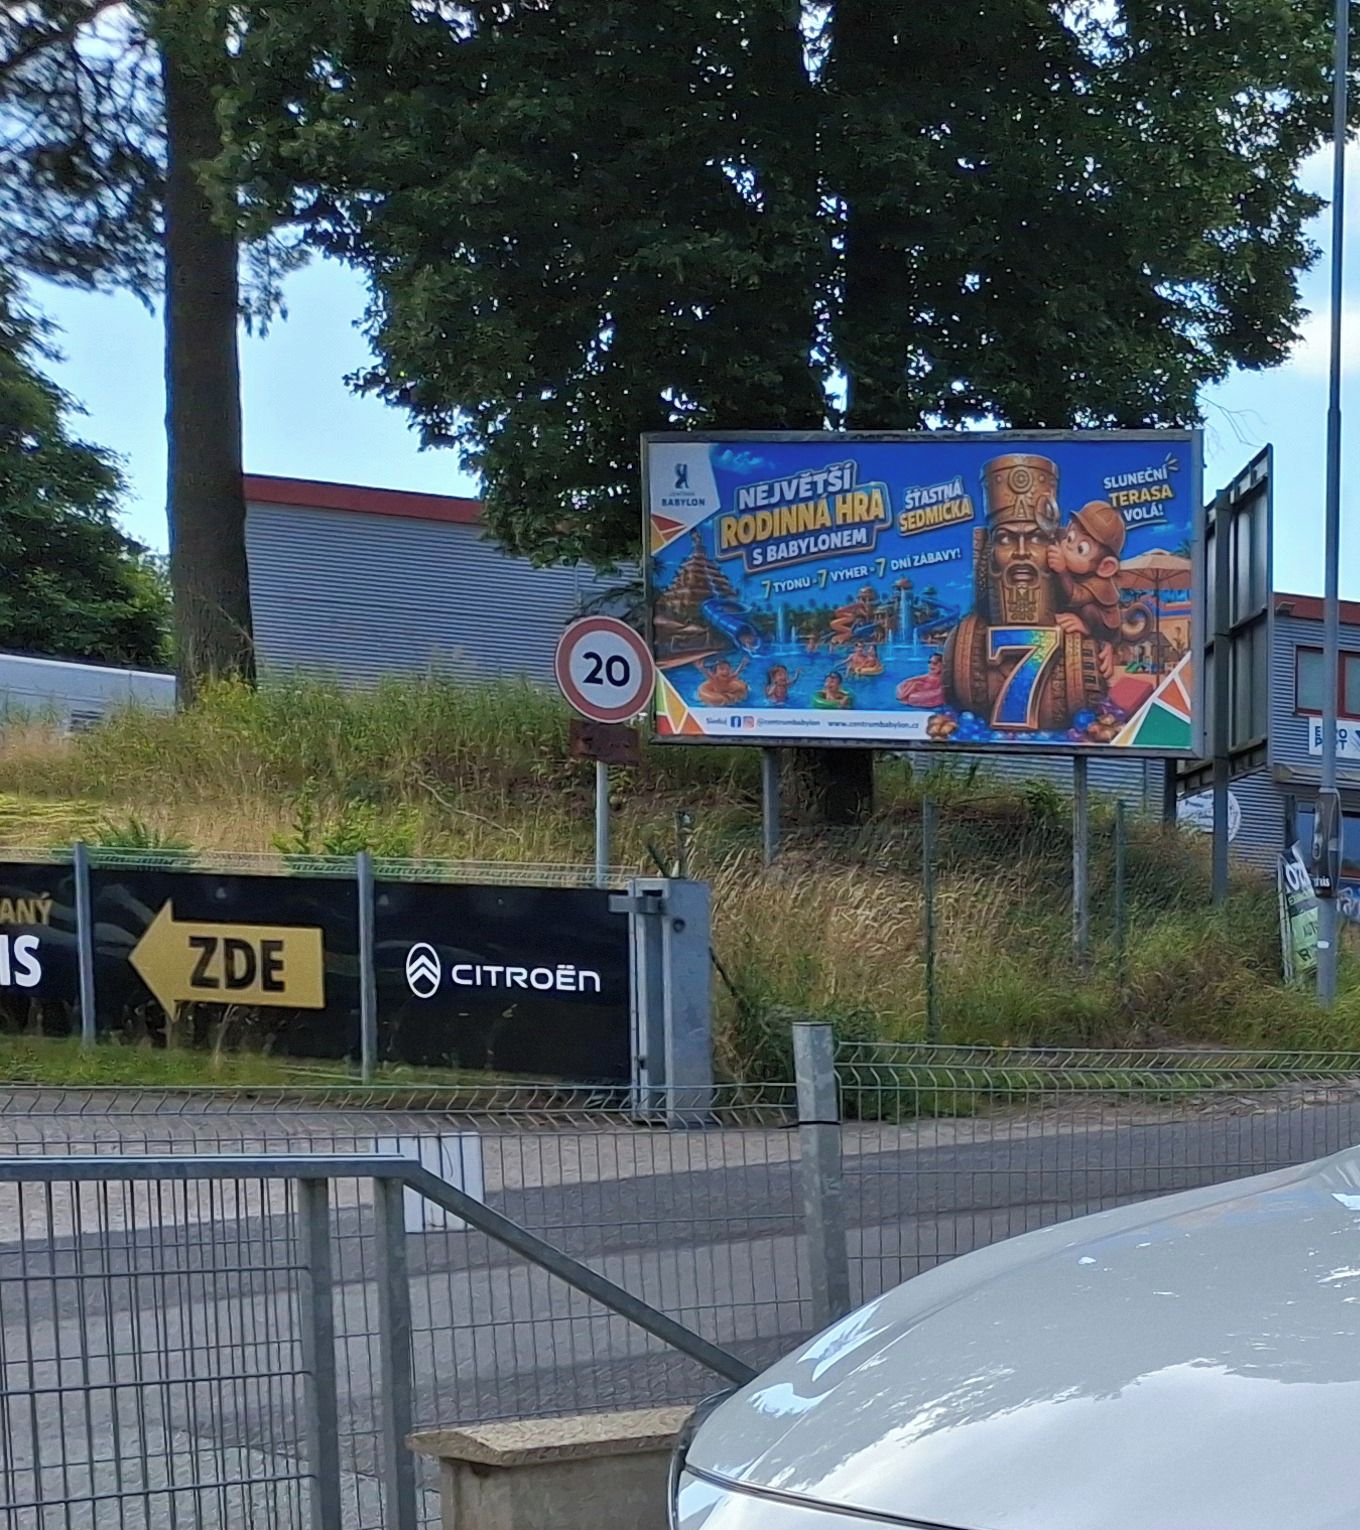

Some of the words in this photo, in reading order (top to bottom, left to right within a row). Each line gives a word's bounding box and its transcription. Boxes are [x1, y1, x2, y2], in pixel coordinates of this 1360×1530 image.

[738, 462, 853, 510] NEJVĚTŠÍ
[1103, 465, 1168, 490] SLUNEČNÍ
[661, 498, 706, 507] BABYLON
[1109, 484, 1173, 508] TERASA
[720, 494, 832, 549] RODINNÁ
[834, 488, 886, 527] HRA
[1123, 504, 1164, 522] VOLÁ!
[752, 548, 764, 566] S
[766, 527, 868, 561] BABYLONEM
[761, 580, 773, 599] 7
[817, 569, 828, 589] 7
[875, 558, 886, 578] 7
[582, 651, 630, 687] 20
[988, 626, 1061, 728] 7
[1314, 725, 1348, 739] EO
[1314, 737, 1348, 751] PT
[188, 935, 285, 992] ZDE
[450, 963, 601, 993] CITROËN
